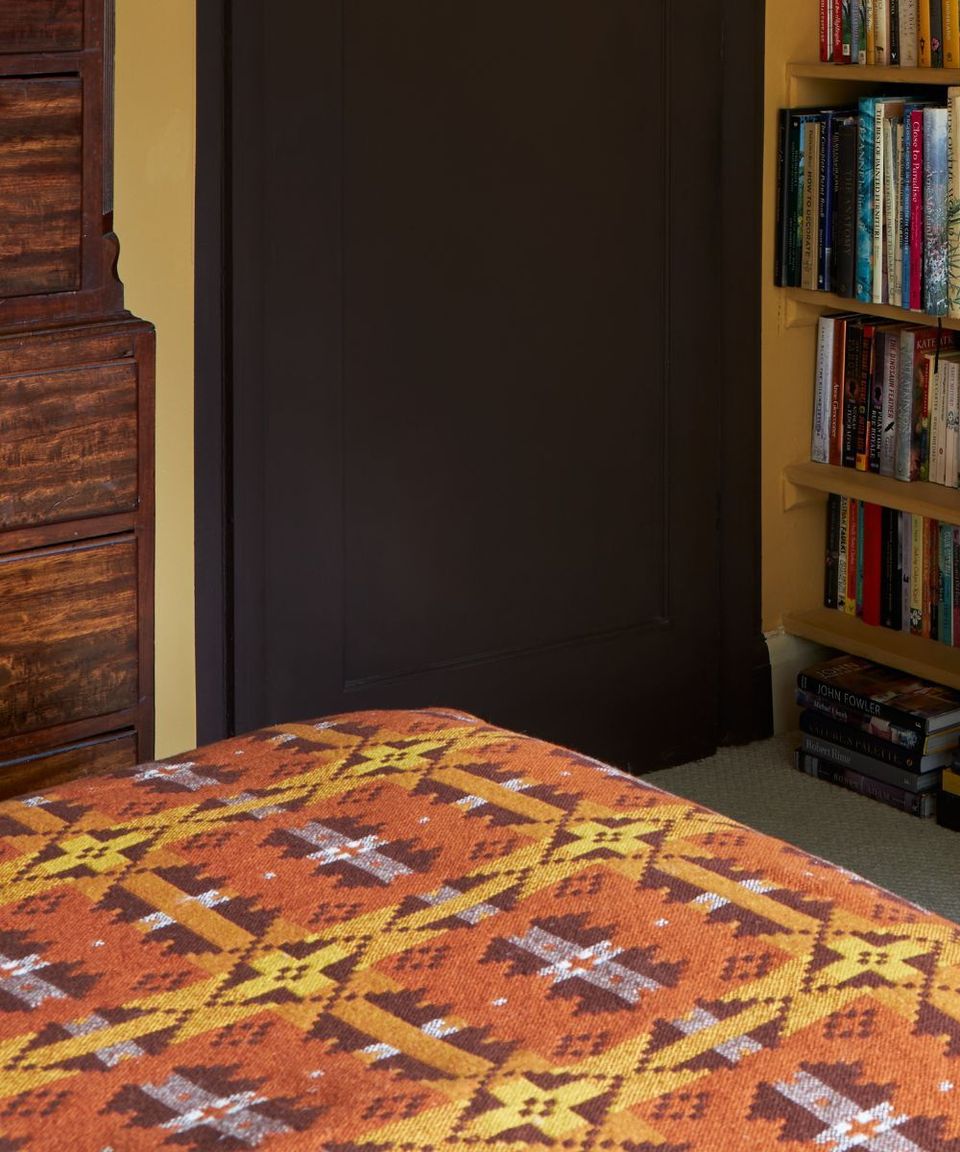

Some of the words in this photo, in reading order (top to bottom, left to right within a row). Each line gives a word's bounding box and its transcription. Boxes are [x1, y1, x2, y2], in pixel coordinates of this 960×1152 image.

[912, 121, 920, 147] Close
[875, 145, 881, 157] OF
[912, 149, 920, 159] to
[912, 162, 920, 203] Paradise
[805, 195, 812, 207] TO
[916, 337, 937, 349] KATE
[888, 353, 896, 388] DINOSAUR
[817, 684, 843, 702] JOHN
[844, 693, 881, 715] FOWLER
[806, 738, 831, 757] Robert
